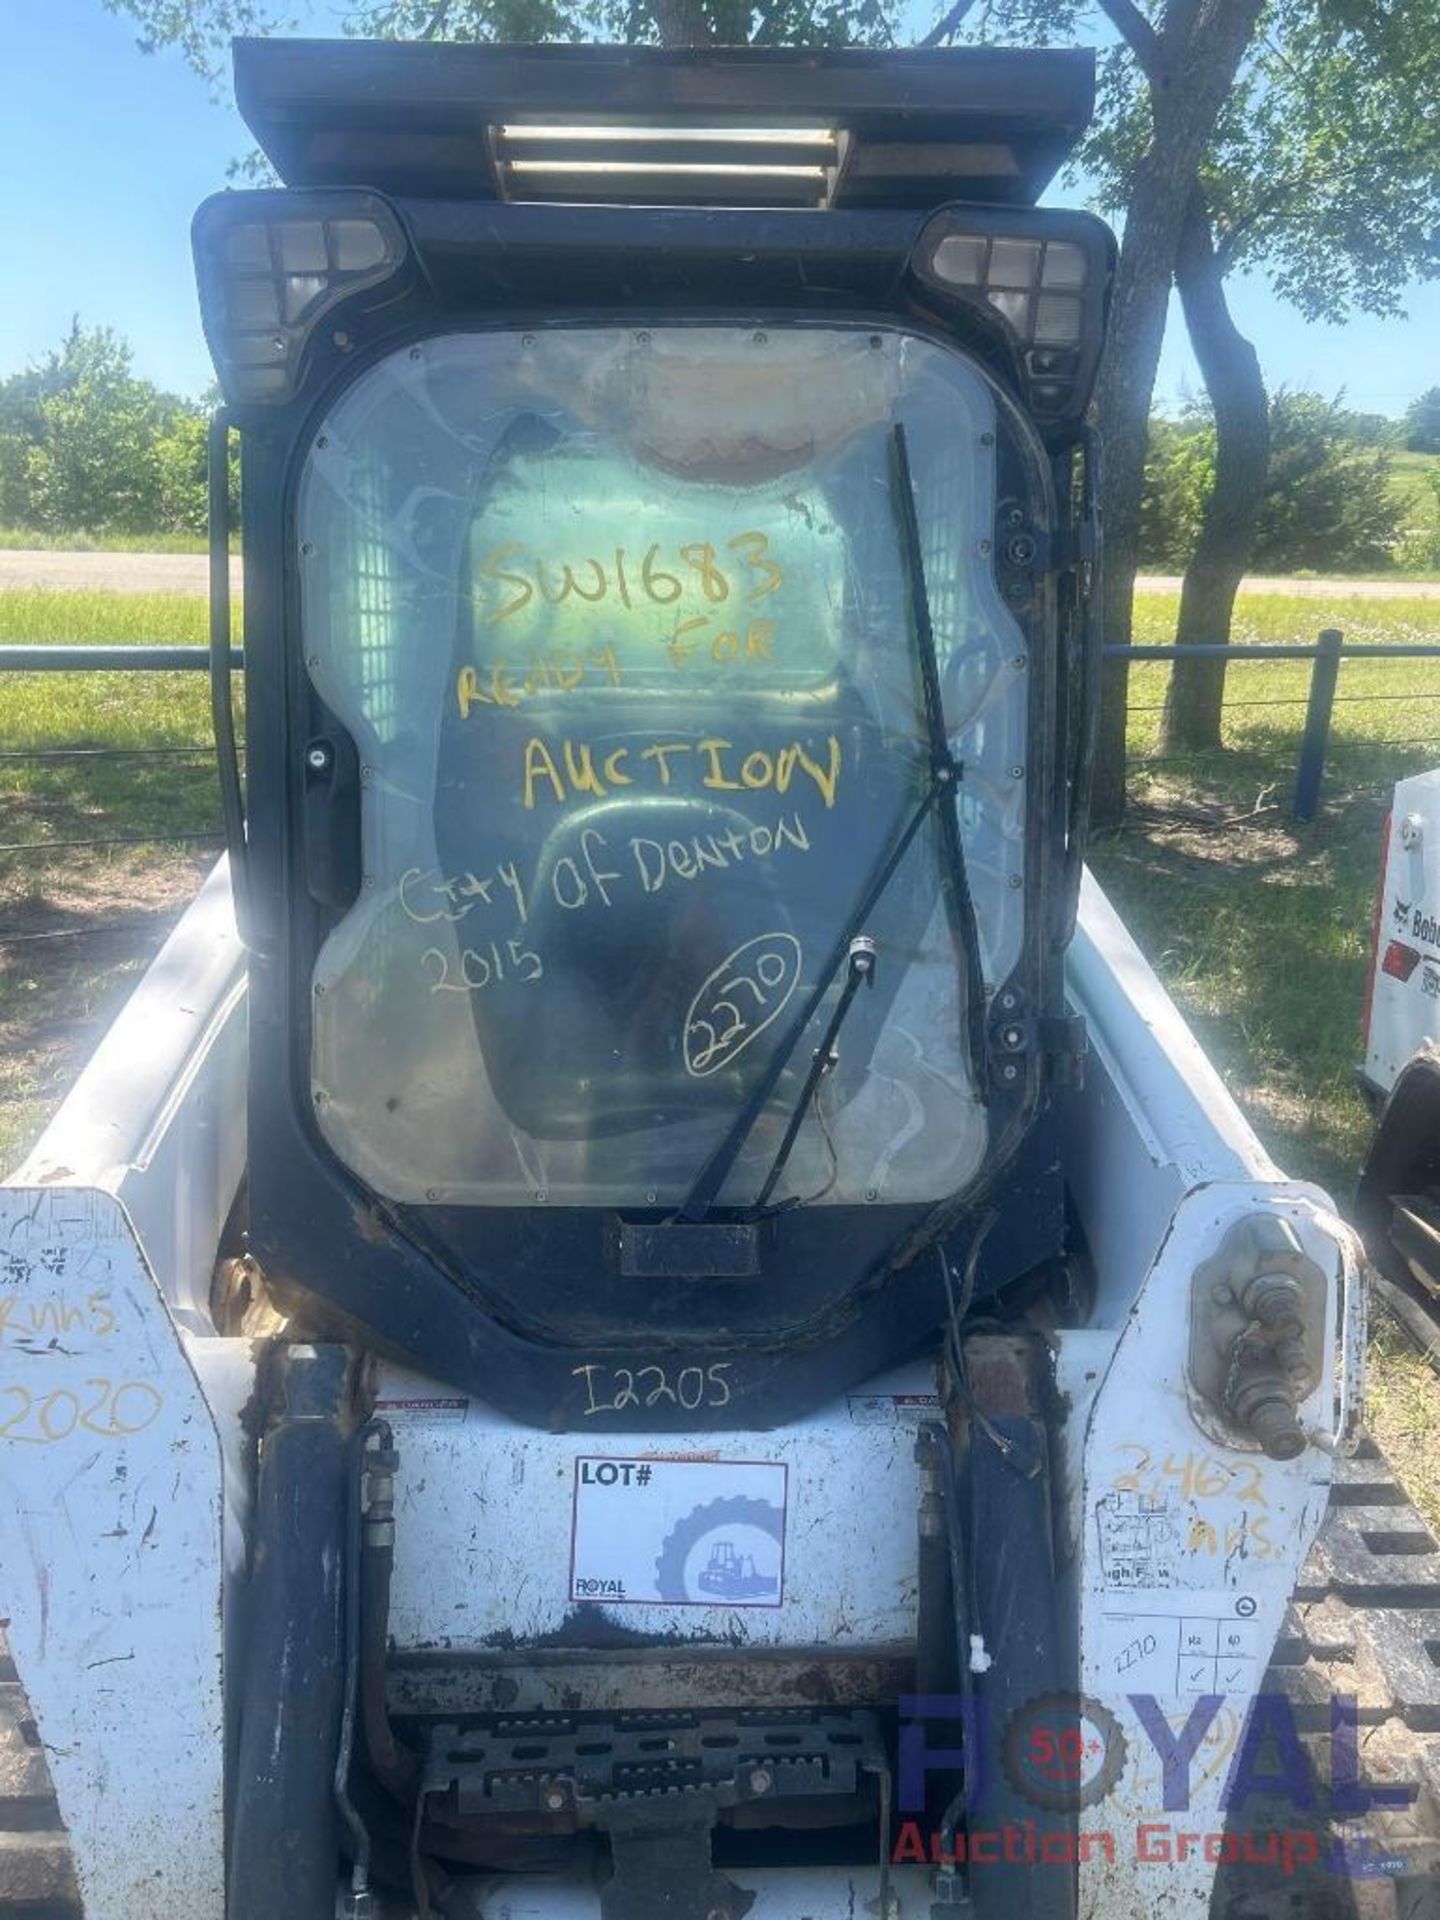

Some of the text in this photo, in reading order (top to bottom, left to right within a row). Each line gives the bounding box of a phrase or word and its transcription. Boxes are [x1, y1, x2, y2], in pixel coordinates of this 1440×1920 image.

[481, 531, 782, 624] SW1683
[523, 735, 842, 808] AUCTION
[420, 938, 543, 994] 2015
[690, 953, 786, 1069] 2270
[0, 1378, 163, 1443] 2020
[581, 1462, 653, 1487] LOT#
